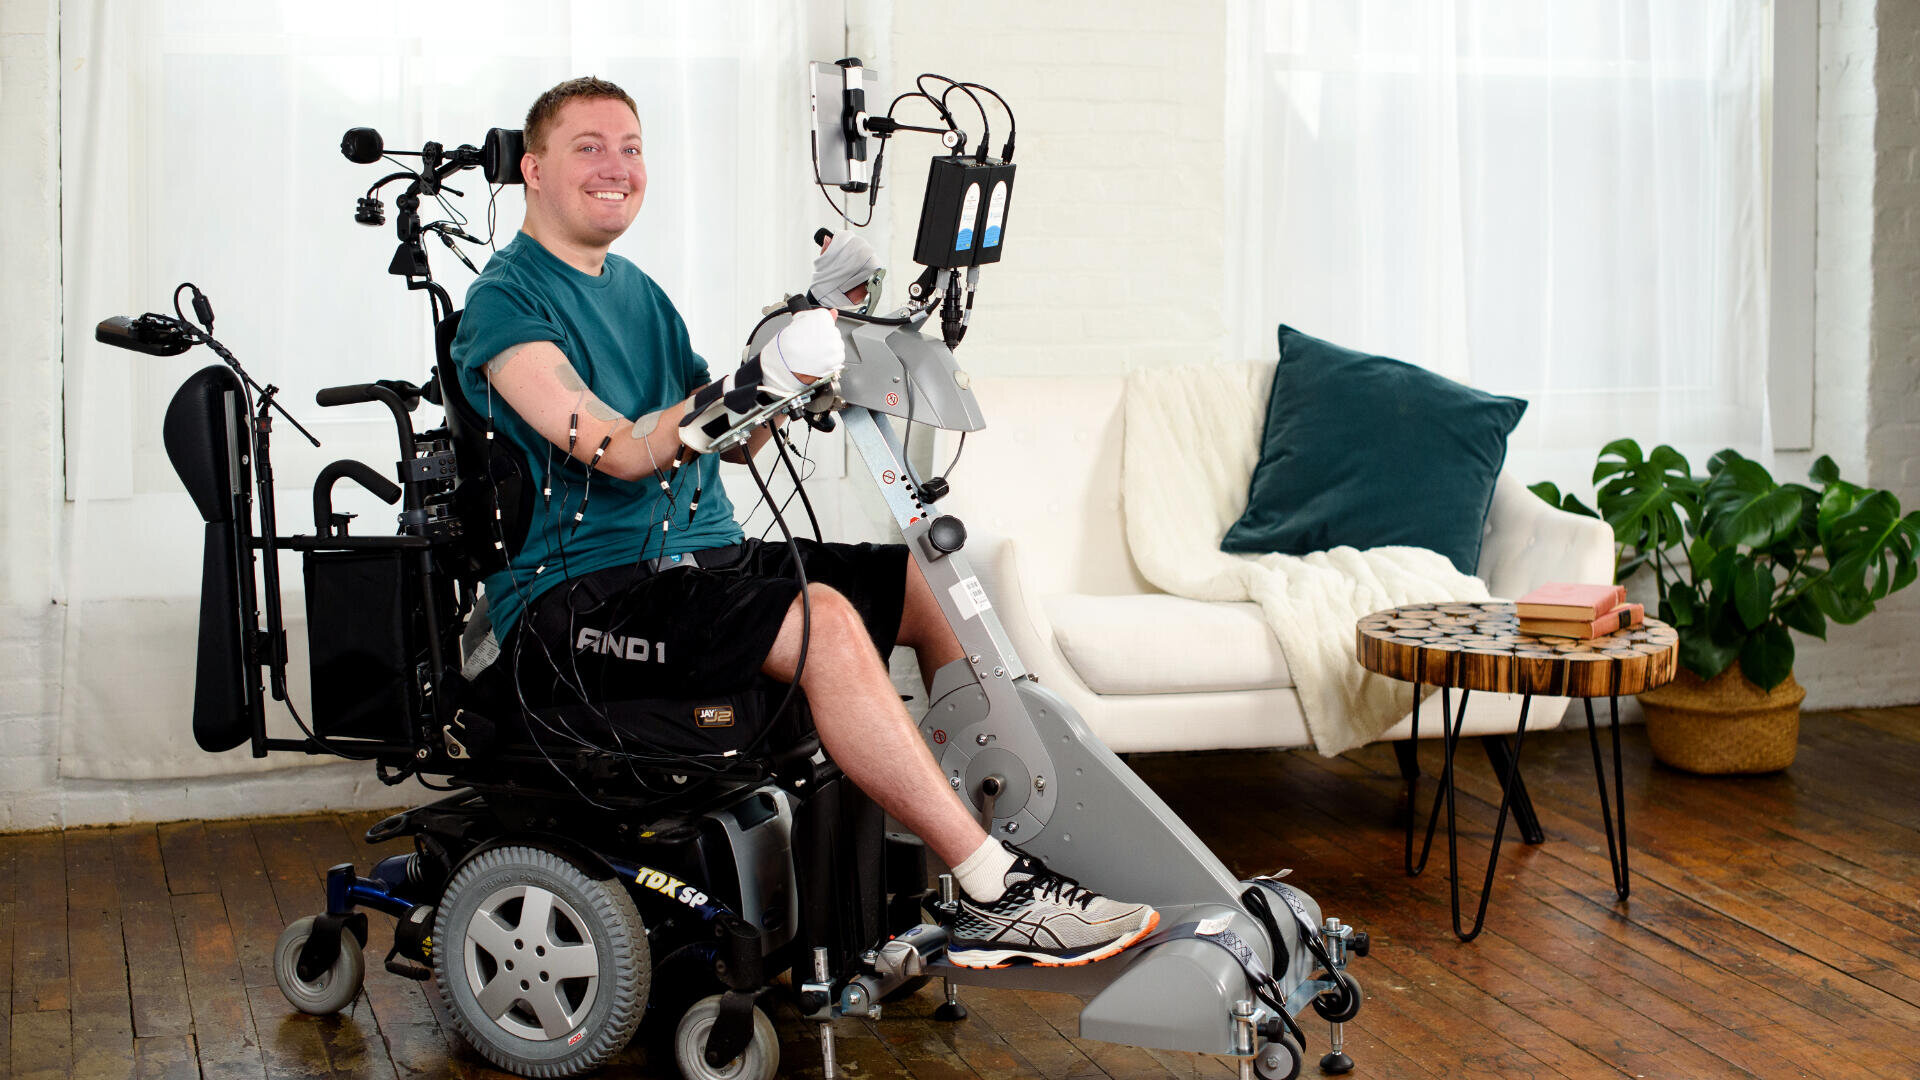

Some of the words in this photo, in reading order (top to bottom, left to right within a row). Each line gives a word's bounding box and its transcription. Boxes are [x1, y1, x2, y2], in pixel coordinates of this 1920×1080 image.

[576, 627, 649, 662] AND
[656, 642, 665, 664] 1
[700, 709, 715, 718] JAY
[635, 866, 686, 899] TDX
[678, 886, 708, 908] SP
